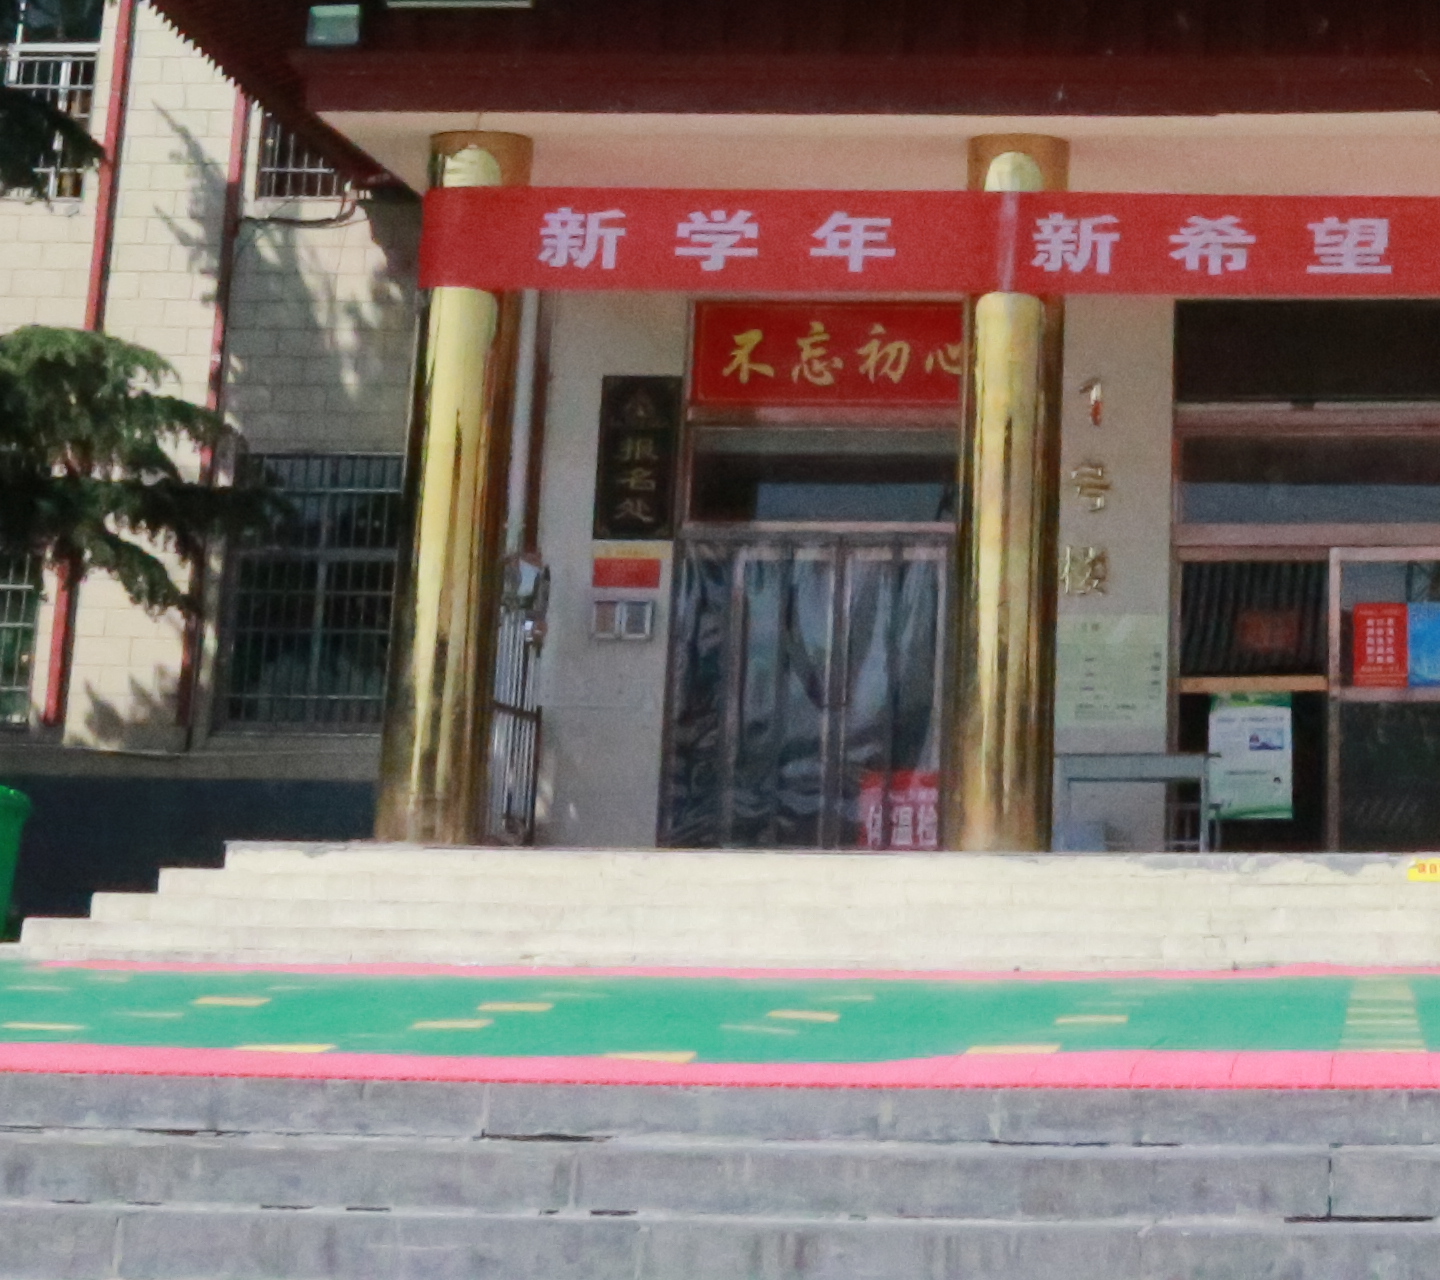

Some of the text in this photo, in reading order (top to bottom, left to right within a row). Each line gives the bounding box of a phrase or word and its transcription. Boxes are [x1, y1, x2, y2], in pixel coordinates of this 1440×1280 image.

[538, 206, 897, 272] 新学年
[1031, 211, 1395, 276] 新希望
[721, 320, 964, 386] 不忘初心
[613, 436, 659, 523] 报名处
[1060, 376, 1112, 596] 1号楼
